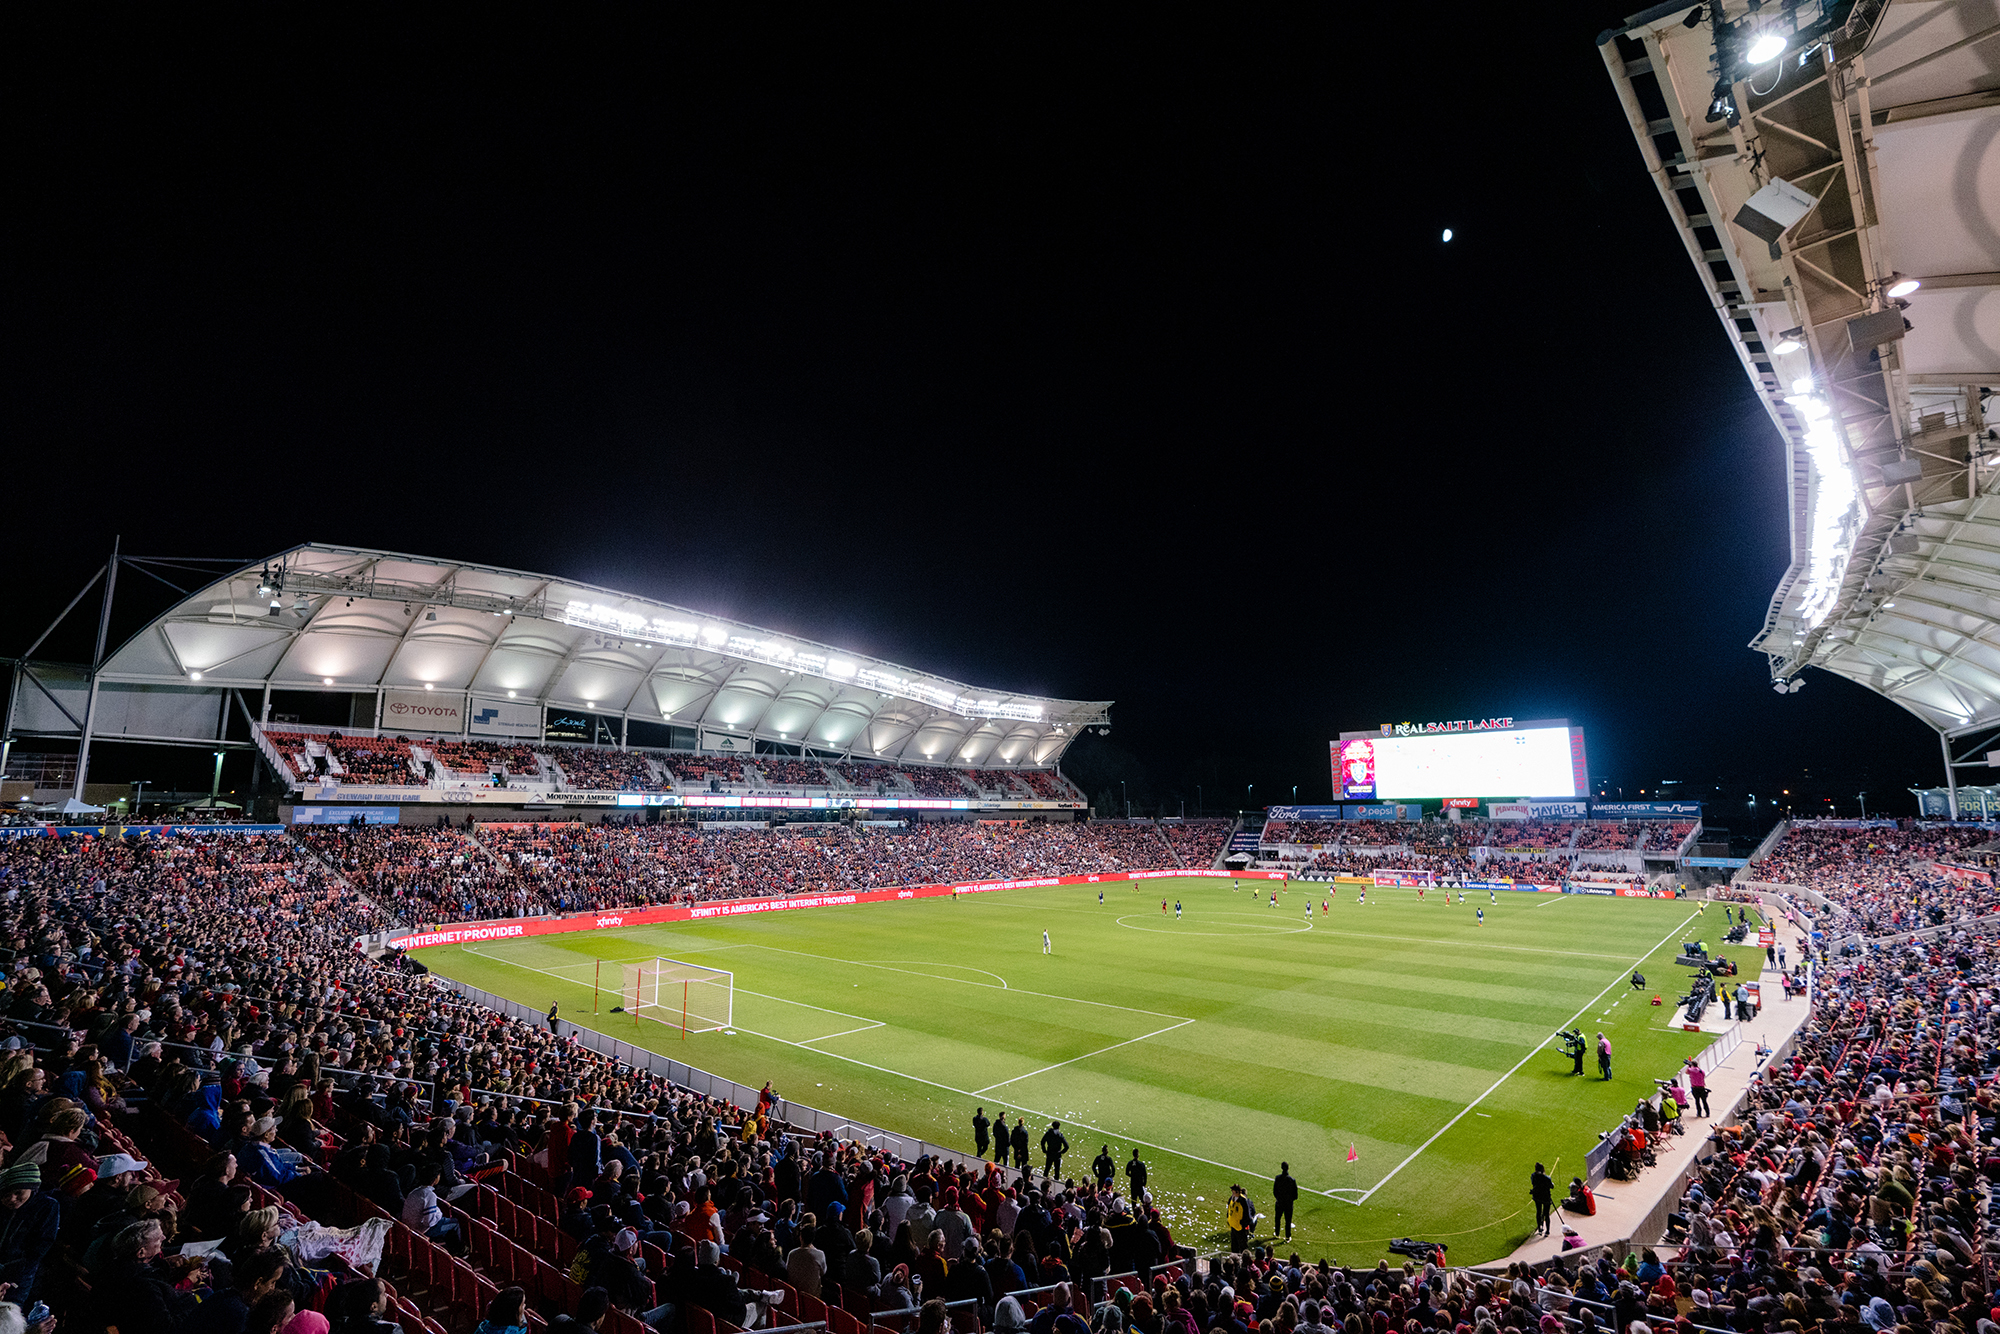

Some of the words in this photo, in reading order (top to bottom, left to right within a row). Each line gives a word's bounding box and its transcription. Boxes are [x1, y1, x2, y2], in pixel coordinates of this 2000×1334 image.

[410, 705, 458, 717] TOYOTA
[1426, 720, 1466, 732] SALT
[1467, 717, 1514, 730] LAKE
[1450, 798, 1472, 807] xfinity
[1270, 806, 1300, 819] Ford
[1368, 806, 1392, 816] pepsi
[1495, 805, 1530, 816] MAVERIK
[1530, 804, 1577, 817] MAYHEM
[898, 890, 913, 899] xfinity
[691, 908, 721, 918] XFINITY
[731, 902, 769, 914] AMERICA'S
[770, 901, 788, 909] BEST
[789, 898, 822, 908] INTERNET
[823, 895, 856, 905] PROVIDER
[596, 916, 623, 928] xfinity
[409, 931, 462, 947] INTERNET
[465, 925, 523, 940] PROVIDER
